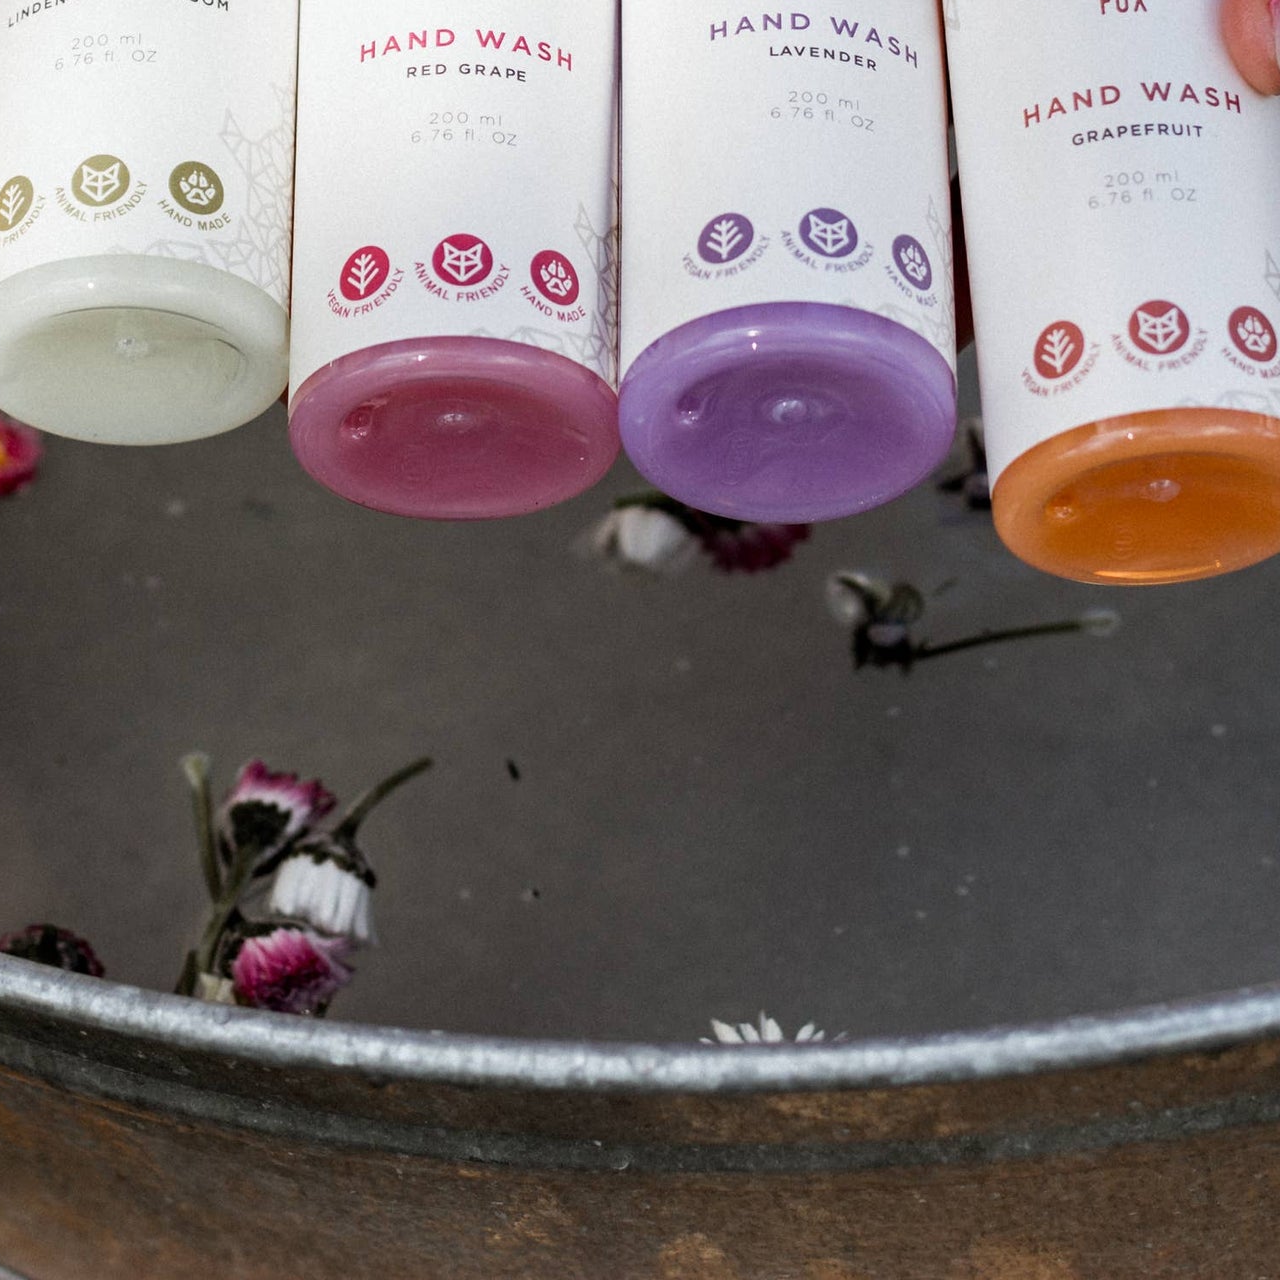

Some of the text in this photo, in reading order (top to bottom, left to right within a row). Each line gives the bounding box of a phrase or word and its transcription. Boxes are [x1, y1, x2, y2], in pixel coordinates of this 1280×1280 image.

[71, 32, 142, 50] 200 ml
[360, 28, 573, 71] HAND WASH
[710, 12, 918, 69] HAND WASH
[769, 45, 877, 71] LAVENDER
[406, 63, 527, 83] RED GRAPE
[429, 111, 502, 126] 200 ml
[788, 90, 860, 111] 200 ml
[1023, 82, 1241, 128] HAND WASH
[1072, 123, 1204, 146] GRAPEFRUIT
[1104, 170, 1179, 188] 200 ml
[2, 194, 47, 247] FRIENDLY
[55, 180, 148, 222] ANIMAL FRIENDLY
[158, 200, 232, 232] HAND MADE
[682, 234, 771, 280] VEGAN FRIENDLY
[781, 229, 875, 273] ANIMAL FRIENDLY
[327, 267, 405, 319] VEGAN FRIENDLY
[414, 261, 512, 302] ANIMAL FRIENDLY
[885, 264, 913, 298] HAND
[520, 285, 586, 323] HAND MADE
[1020, 341, 1101, 397] VEGAN FRIENDLY
[1111, 327, 1209, 372] ANIMAL FRIENDLY
[1221, 347, 1255, 377] HAND
